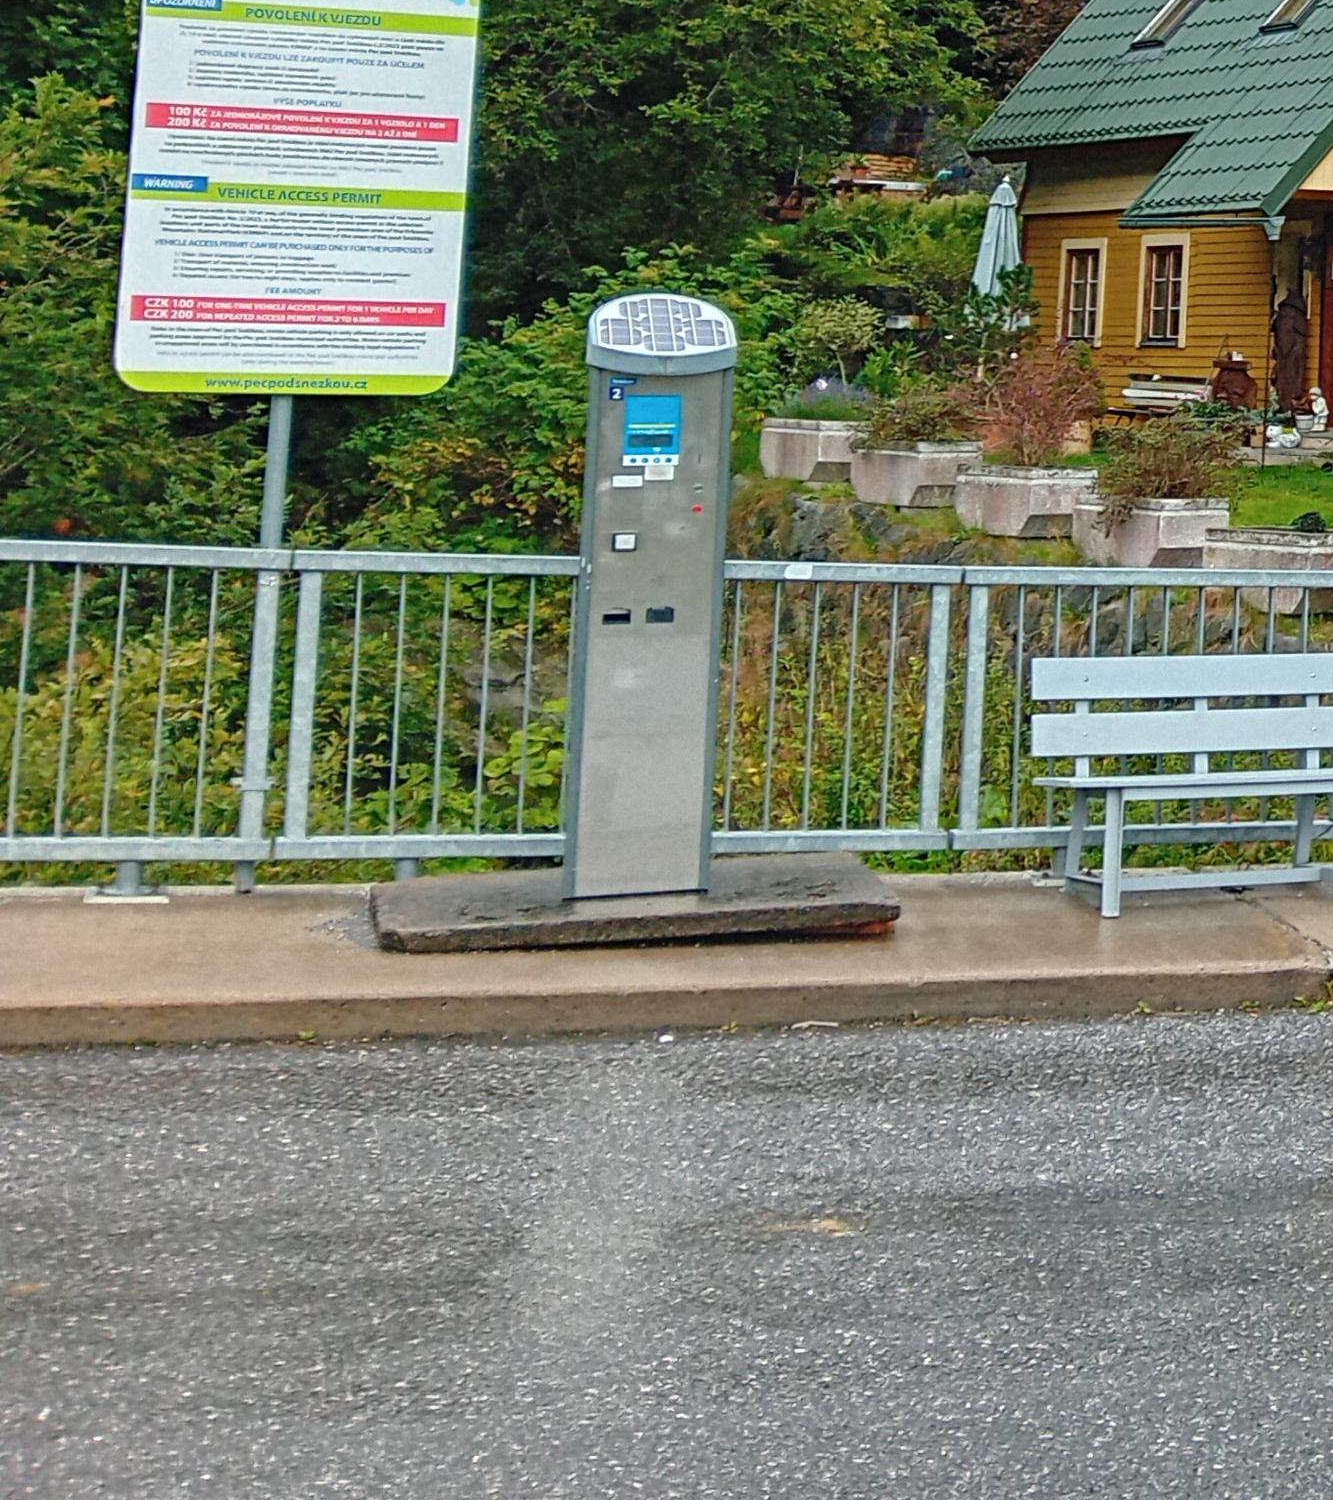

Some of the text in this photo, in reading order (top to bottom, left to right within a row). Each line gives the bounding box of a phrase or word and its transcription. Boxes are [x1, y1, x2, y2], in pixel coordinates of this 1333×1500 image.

[245, 7, 382, 26] POVOLENÍ K VJEZDU
[194, 49, 238, 58] POVOLENÍ
[248, 51, 282, 60] VJEZDU
[347, 57, 375, 66] POUZE
[377, 59, 389, 67] ZA
[167, 117, 190, 126] 200
[192, 118, 207, 127] Kč
[210, 121, 221, 129] ZA
[169, 107, 191, 116] 100
[193, 107, 208, 117] Kč
[210, 110, 222, 118] ZA
[362, 118, 373, 126] ZA
[143, 177, 194, 190] WARNING
[217, 187, 382, 205] VEHICLE ACCESS PERMIT
[154, 239, 187, 247] VEHICLE
[187, 240, 219, 248] ACCESS
[282, 287, 322, 295] AMOUNT
[144, 298, 170, 308] CZK
[173, 299, 194, 309] 100
[418, 307, 434, 315] DAY
[143, 309, 168, 319] CZK
[170, 310, 193, 320] 200
[204, 376, 368, 390] www.pecpodsnezkou.cz
[611, 388, 622, 400] 2
